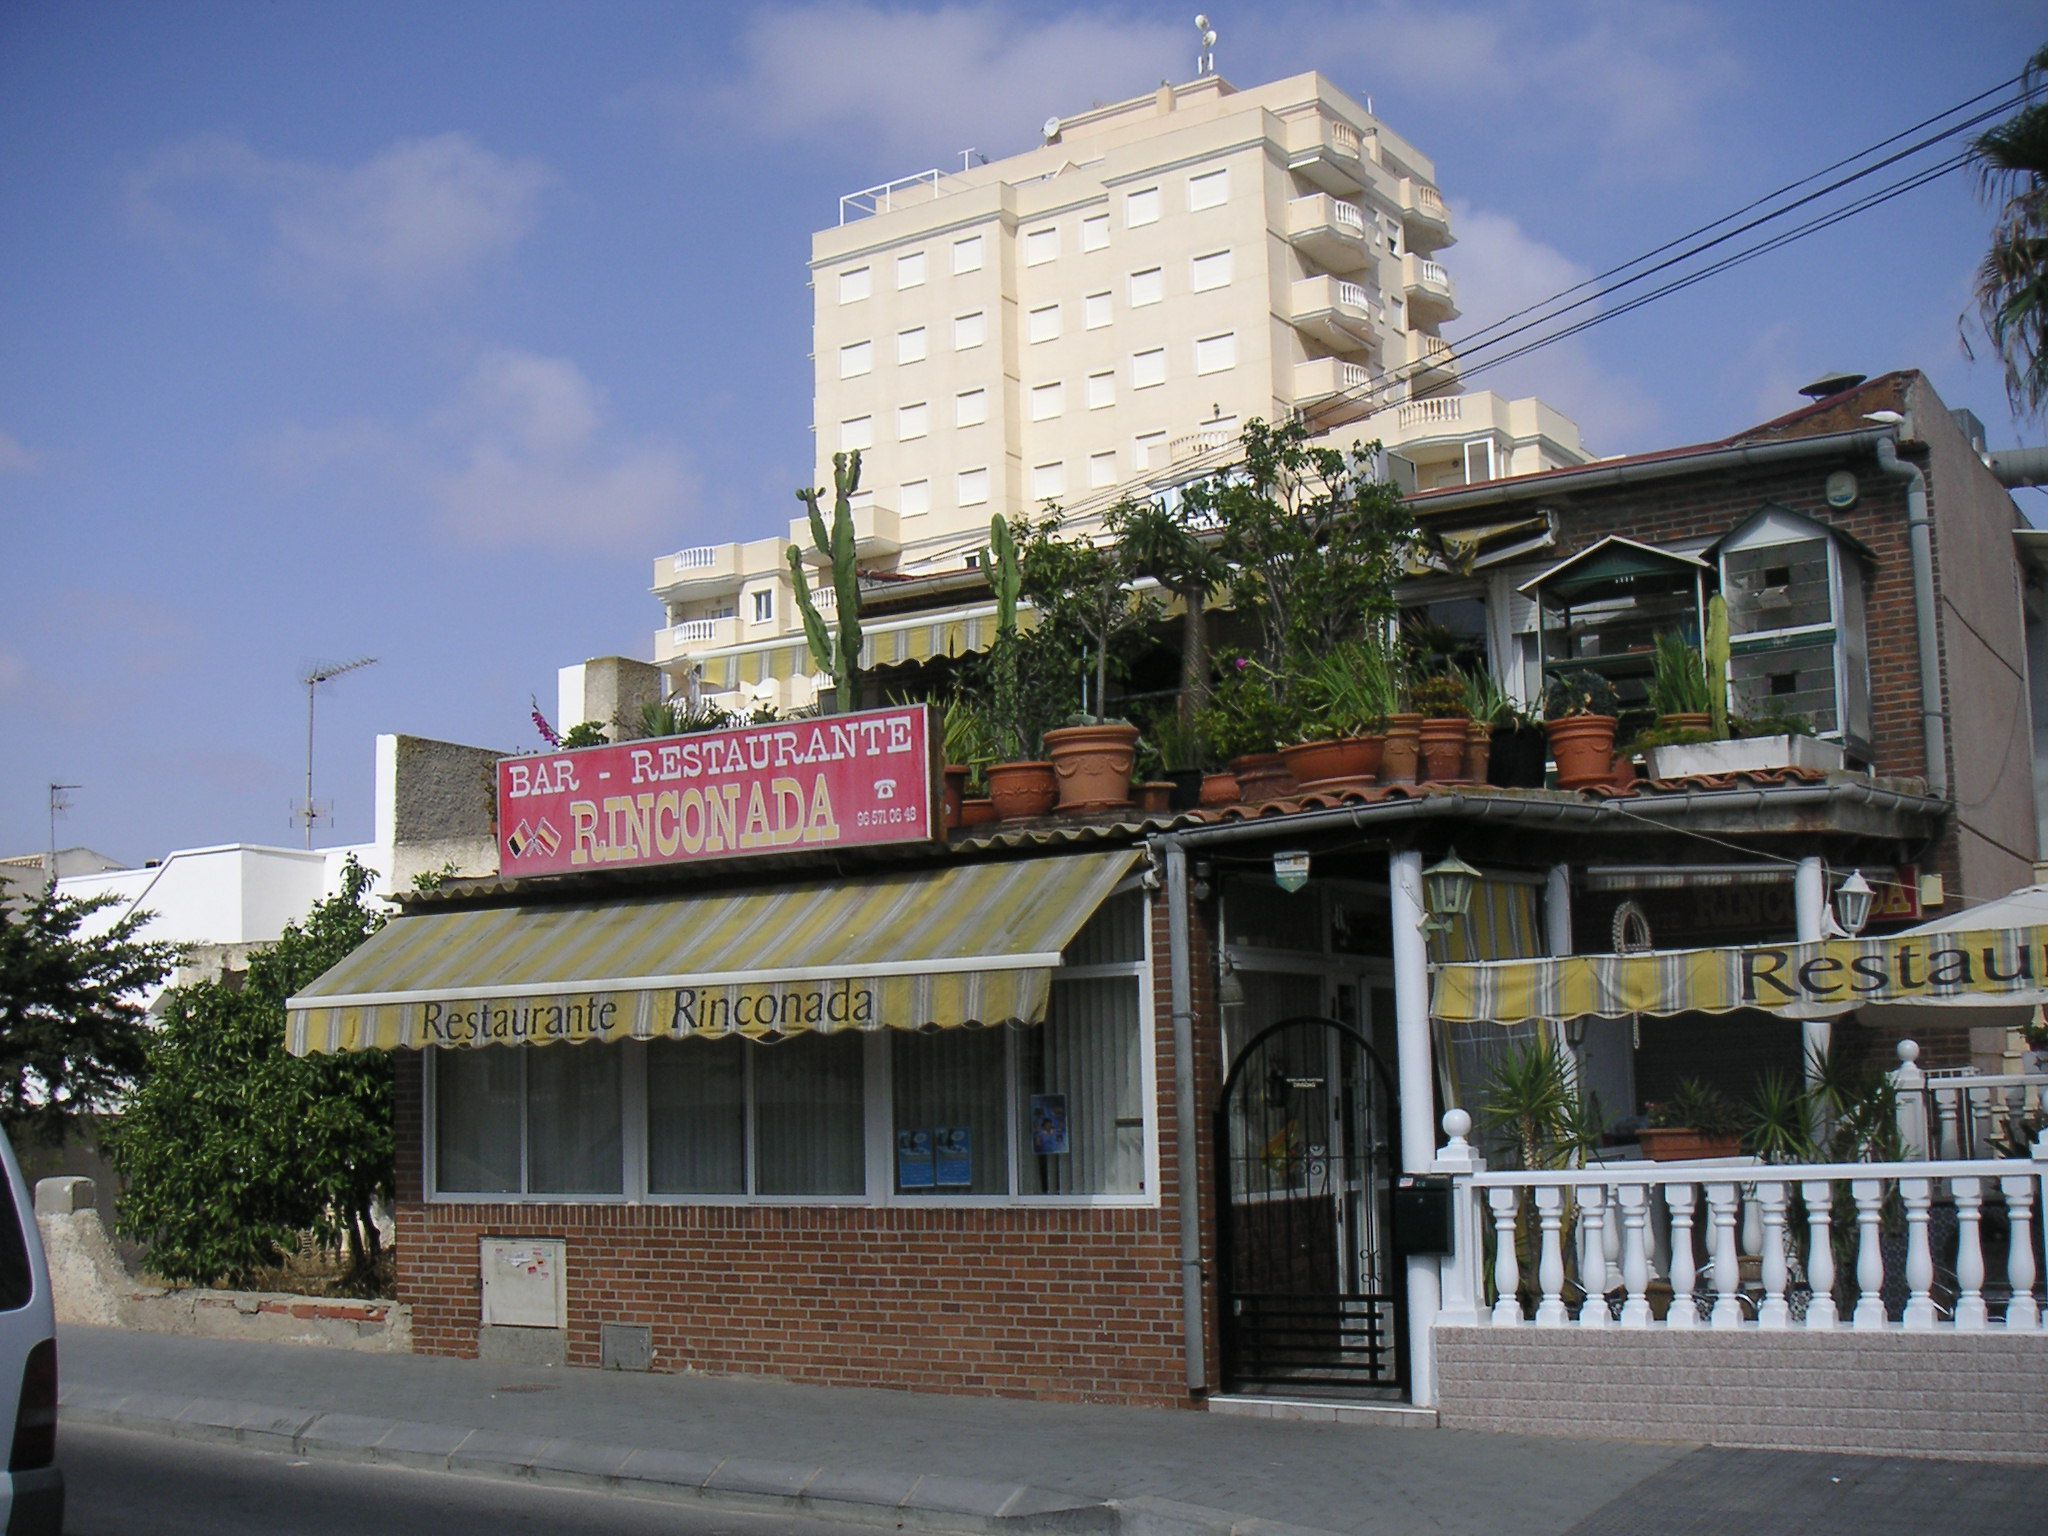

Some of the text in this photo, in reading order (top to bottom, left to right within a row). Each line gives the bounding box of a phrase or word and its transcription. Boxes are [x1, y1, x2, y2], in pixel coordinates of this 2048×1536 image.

[508, 760, 580, 798] BAR
[630, 716, 913, 785] RESTAURANTE
[570, 773, 840, 865] RINCONADA
[857, 810, 870, 827] 96
[871, 809, 888, 826] 571
[903, 805, 917, 823] 48
[1741, 943, 2048, 1001] Restau
[421, 977, 874, 1041] Restaurante Rinconada
